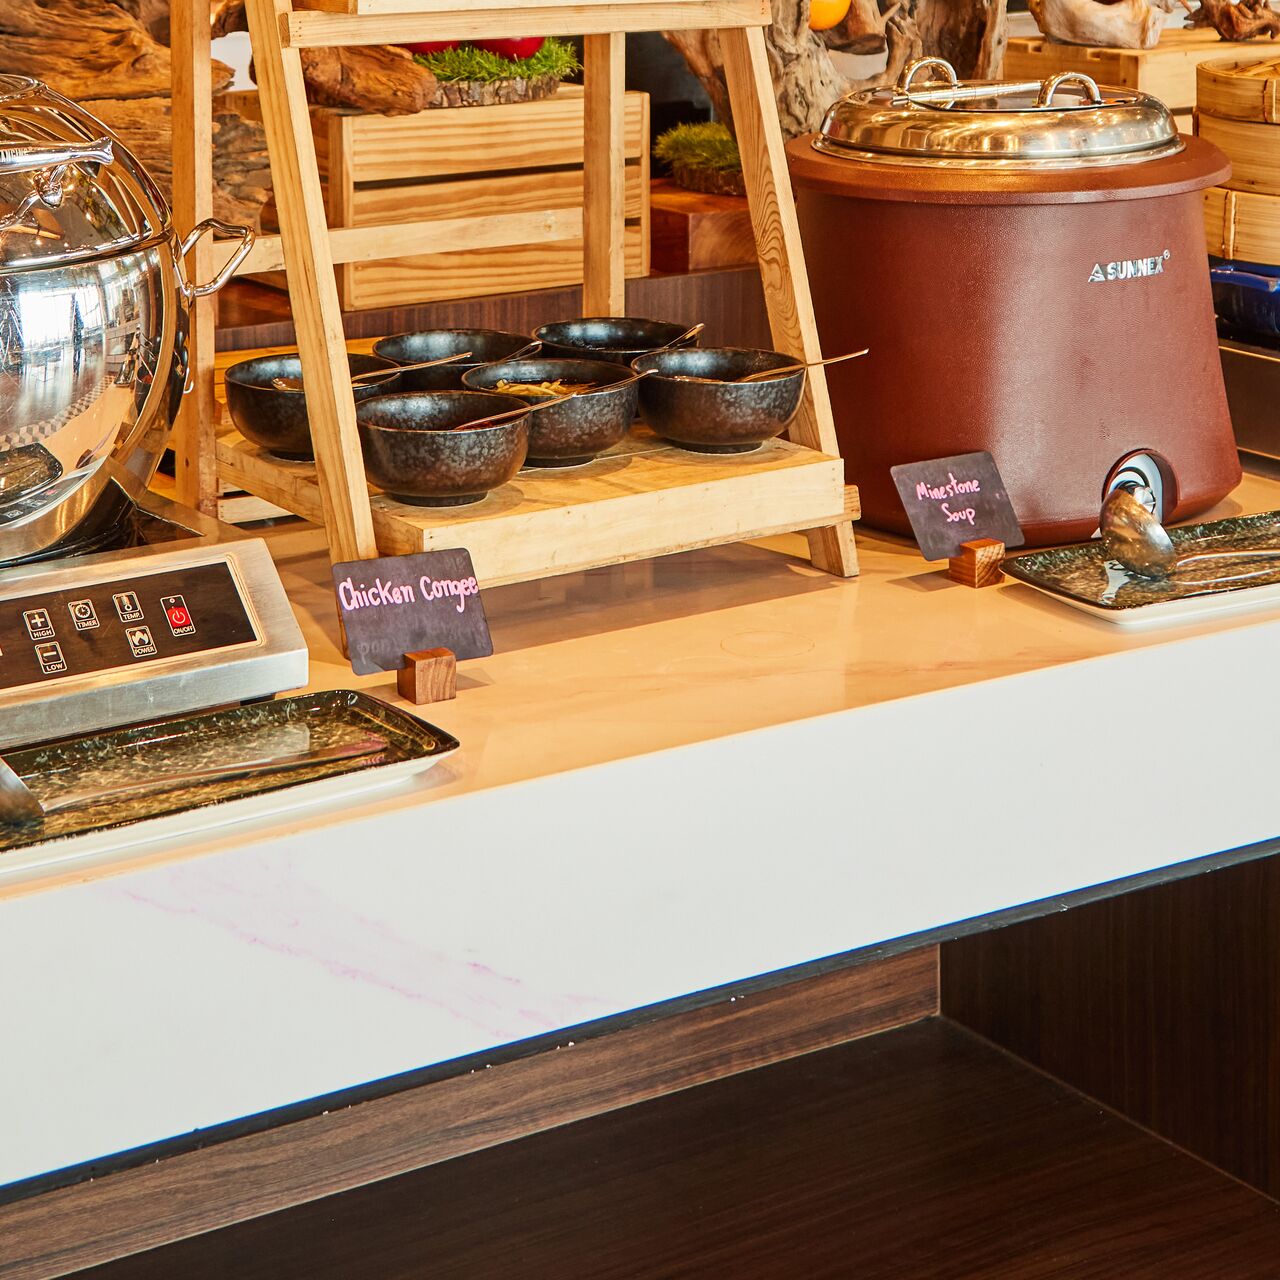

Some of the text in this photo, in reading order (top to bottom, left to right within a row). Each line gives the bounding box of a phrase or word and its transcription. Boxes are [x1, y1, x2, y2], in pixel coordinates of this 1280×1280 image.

[1106, 255, 1164, 280] SUNNEX
[941, 503, 975, 525] Soup
[338, 575, 479, 613] Chicken Congee
[76, 619, 98, 629] TIMER
[33, 629, 52, 638] HIGH
[173, 626, 194, 635] ON/OFF
[134, 646, 155, 656] POWER
[46, 662, 64, 671] LOW
